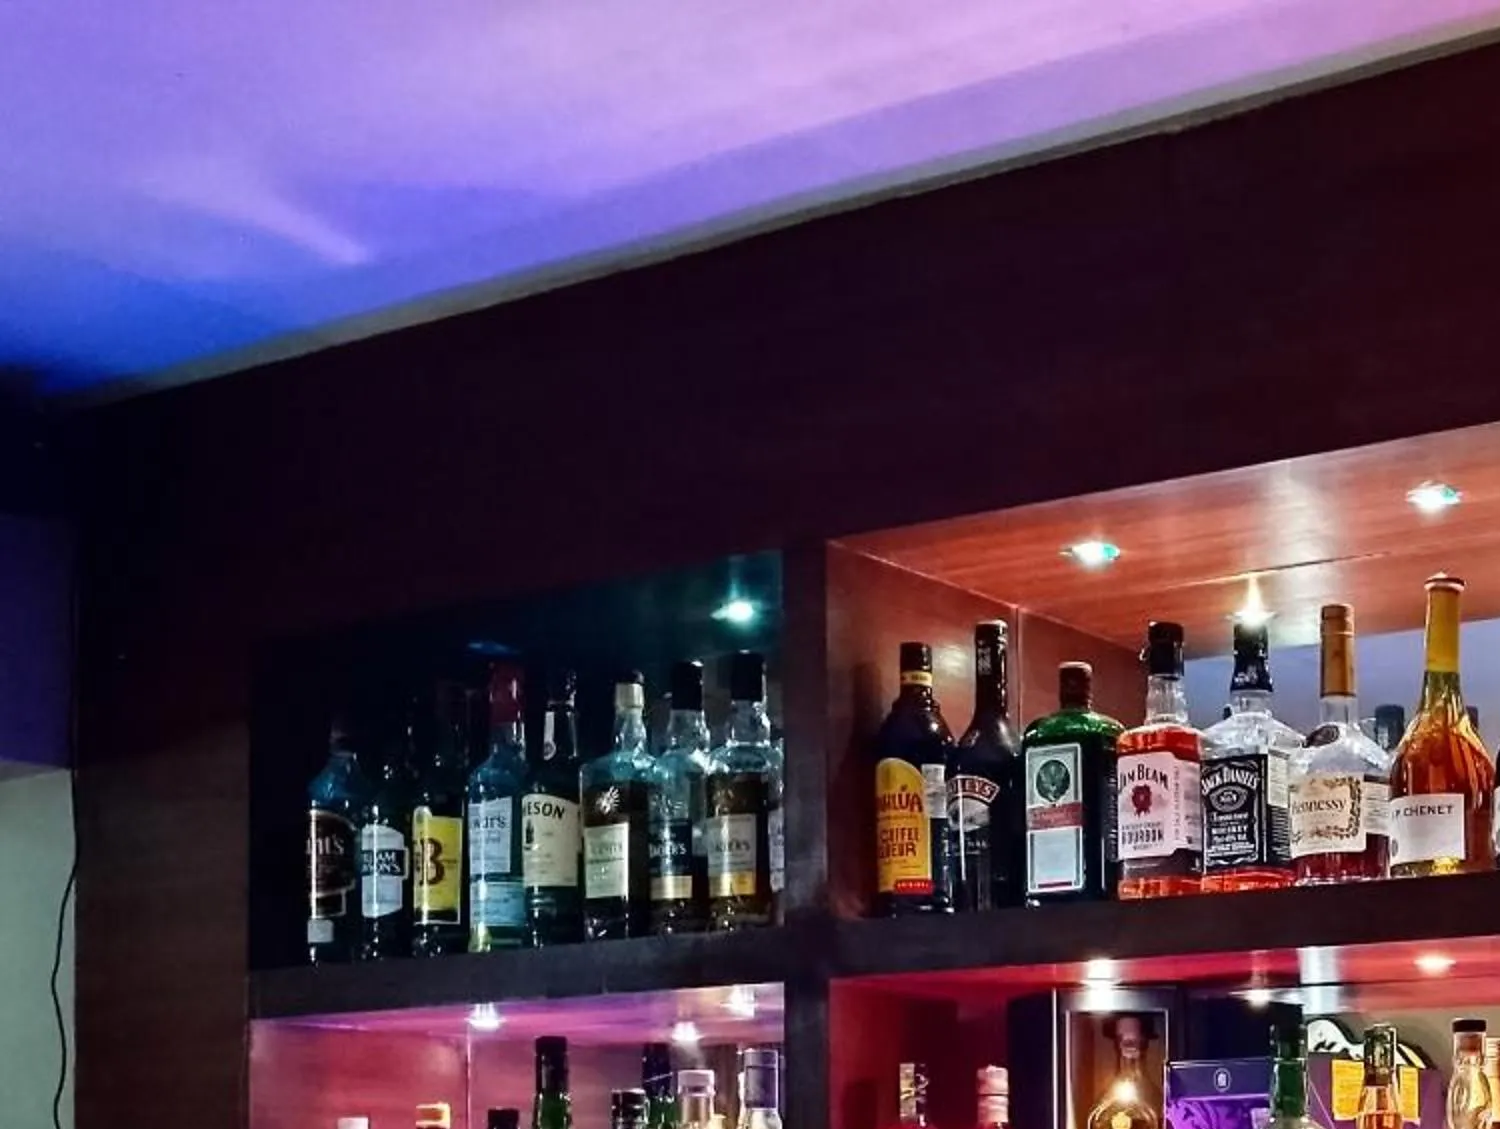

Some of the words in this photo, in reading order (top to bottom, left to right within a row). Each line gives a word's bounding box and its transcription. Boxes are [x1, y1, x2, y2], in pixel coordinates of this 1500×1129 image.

[1201, 771, 1222, 795] JACK
[1403, 803, 1454, 818] CHENET
[419, 837, 445, 886] B
